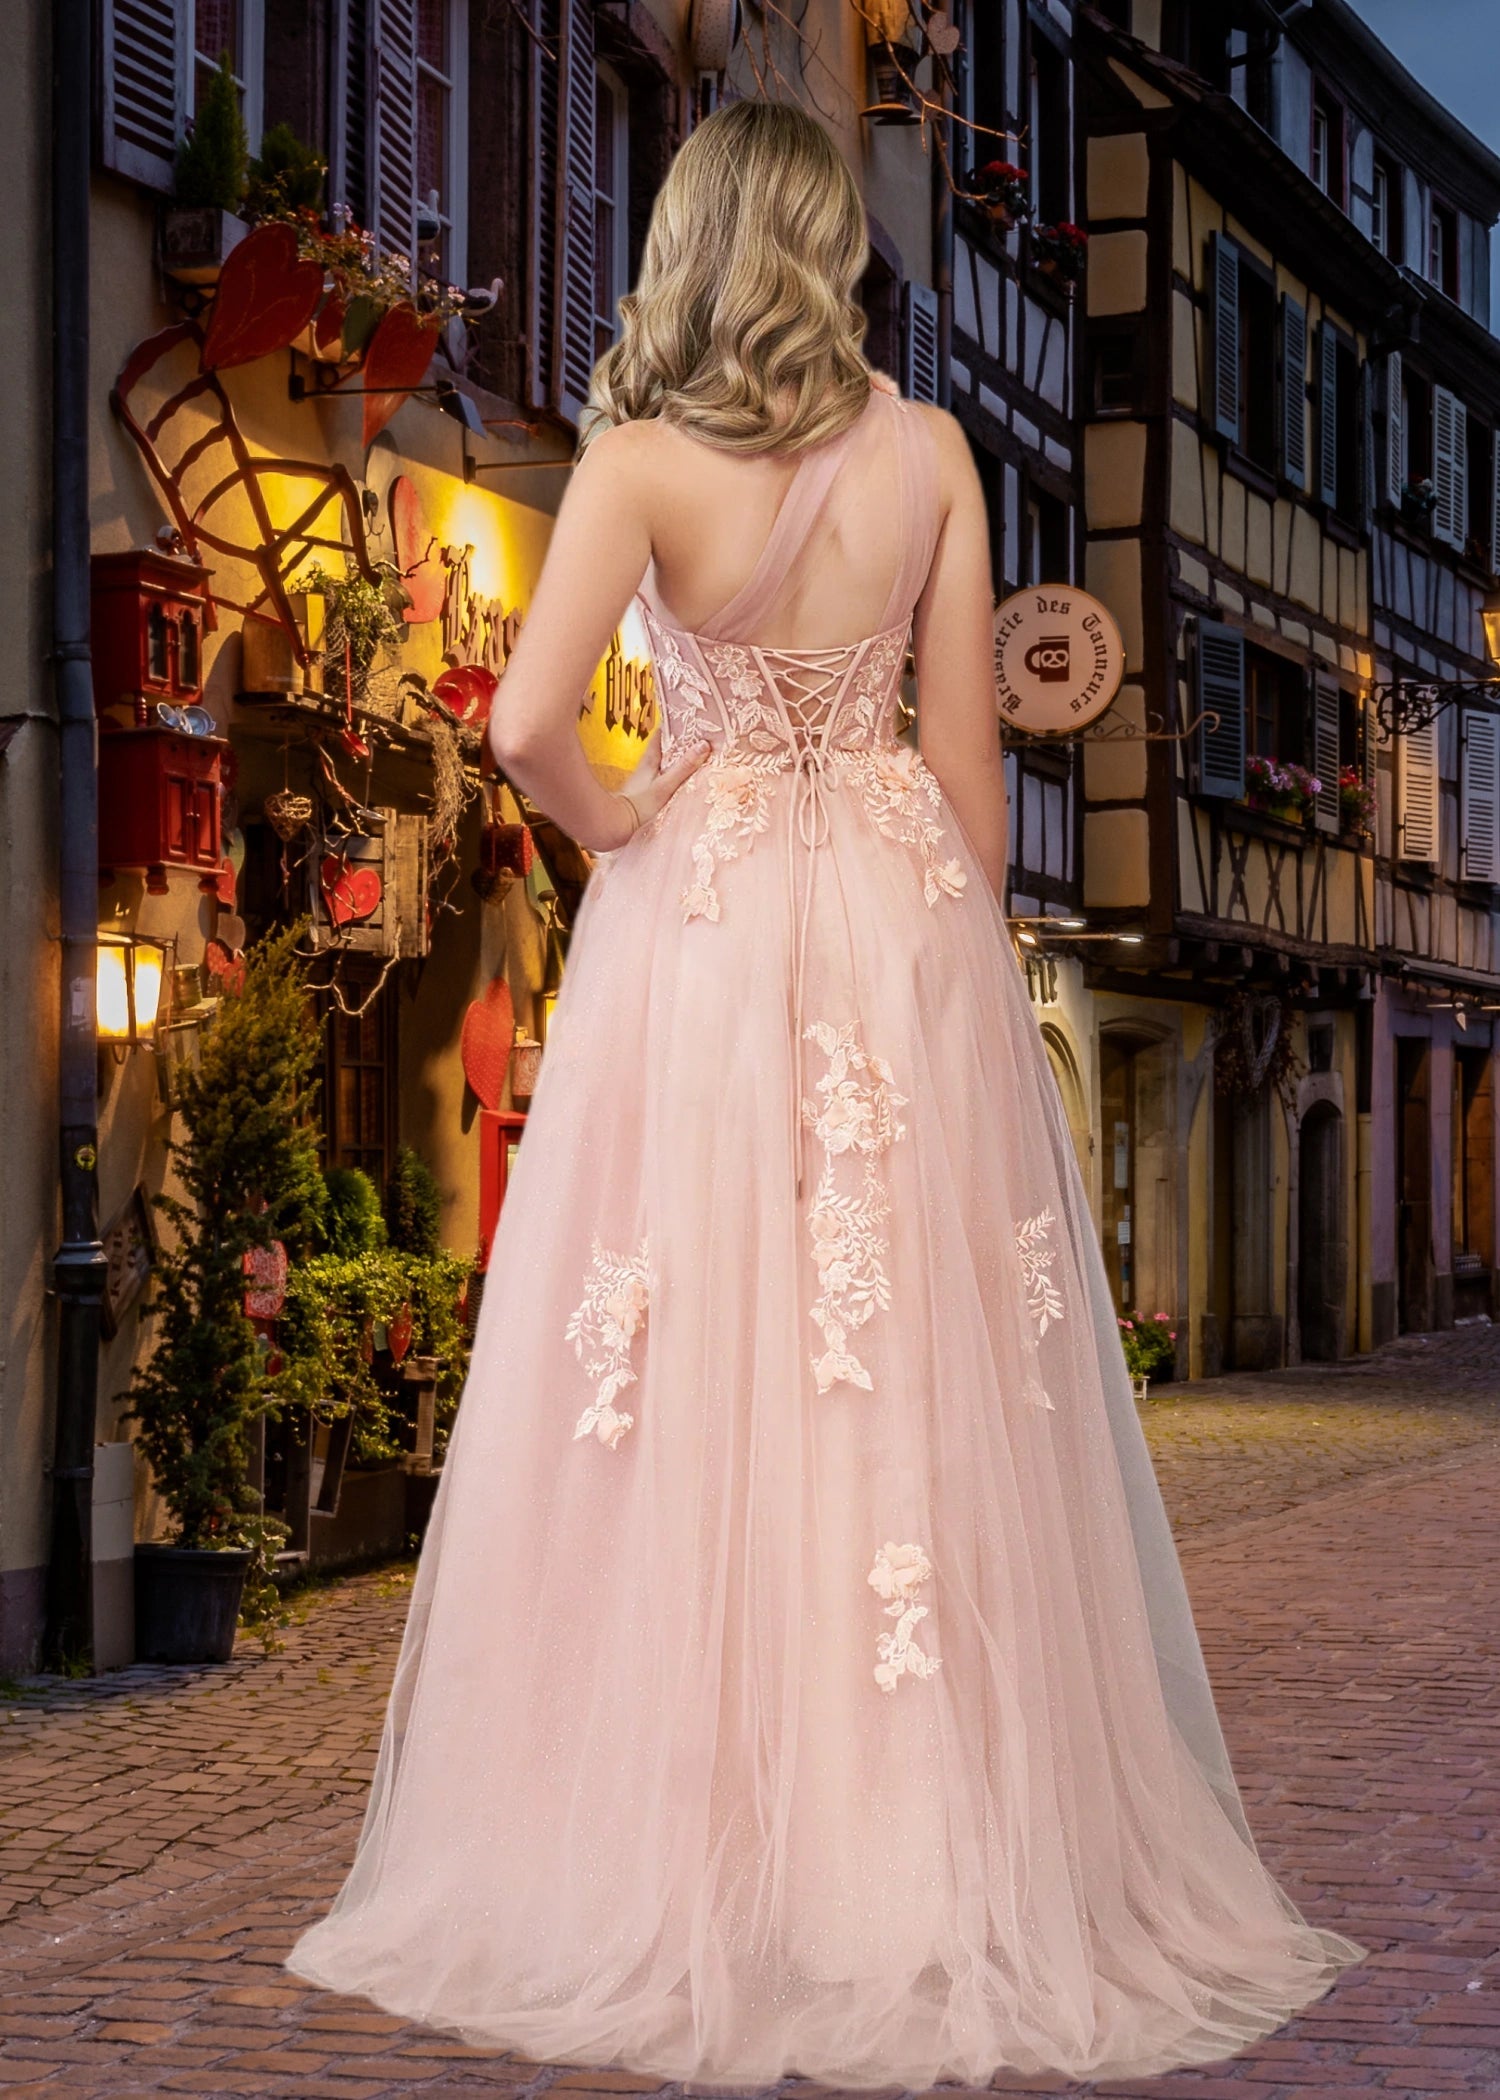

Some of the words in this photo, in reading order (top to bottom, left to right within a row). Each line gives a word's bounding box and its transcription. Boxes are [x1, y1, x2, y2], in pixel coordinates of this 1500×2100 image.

[994, 612, 1023, 715] Brasserie
[1036, 596, 1072, 615] des
[1069, 612, 1108, 713] Tanneurs
